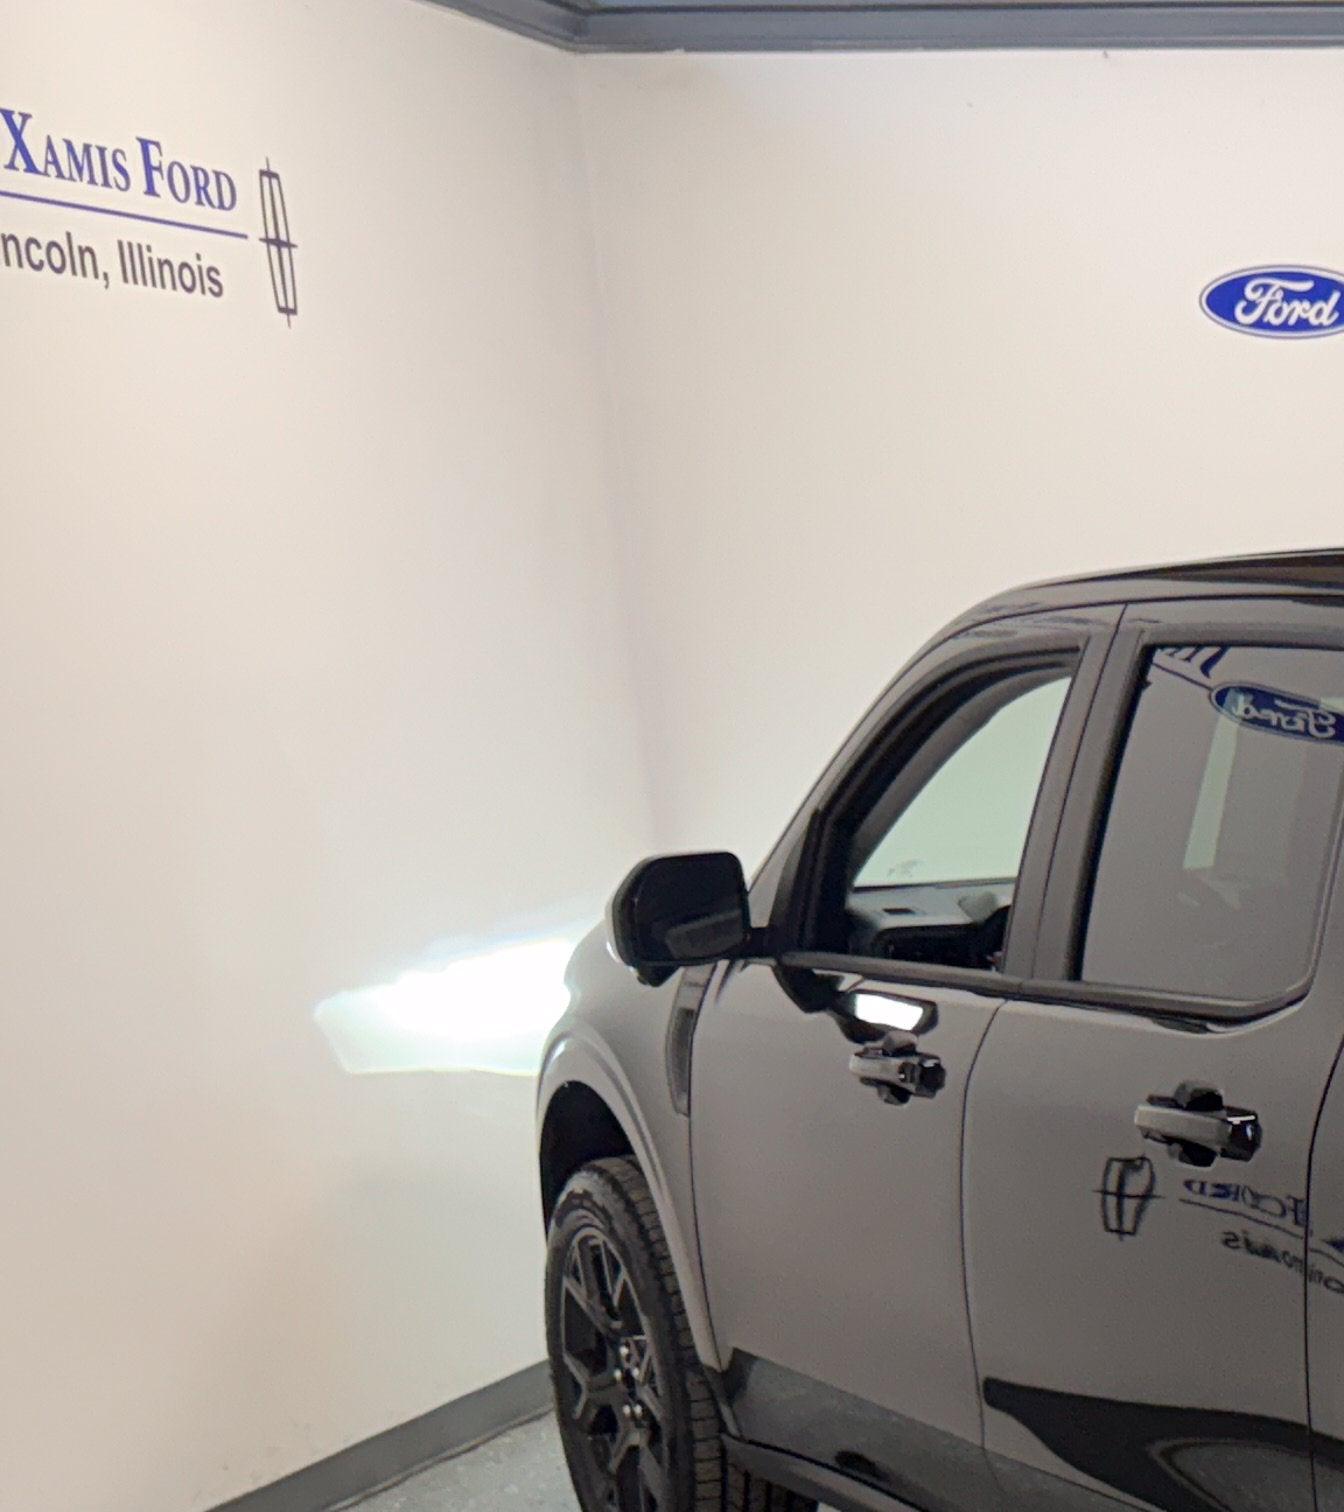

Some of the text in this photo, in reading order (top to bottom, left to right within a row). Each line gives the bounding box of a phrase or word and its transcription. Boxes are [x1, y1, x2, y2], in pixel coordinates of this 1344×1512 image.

[136, 136, 238, 212] FORD
[117, 239, 224, 298] Illinois
[1234, 277, 1342, 327] Ford
